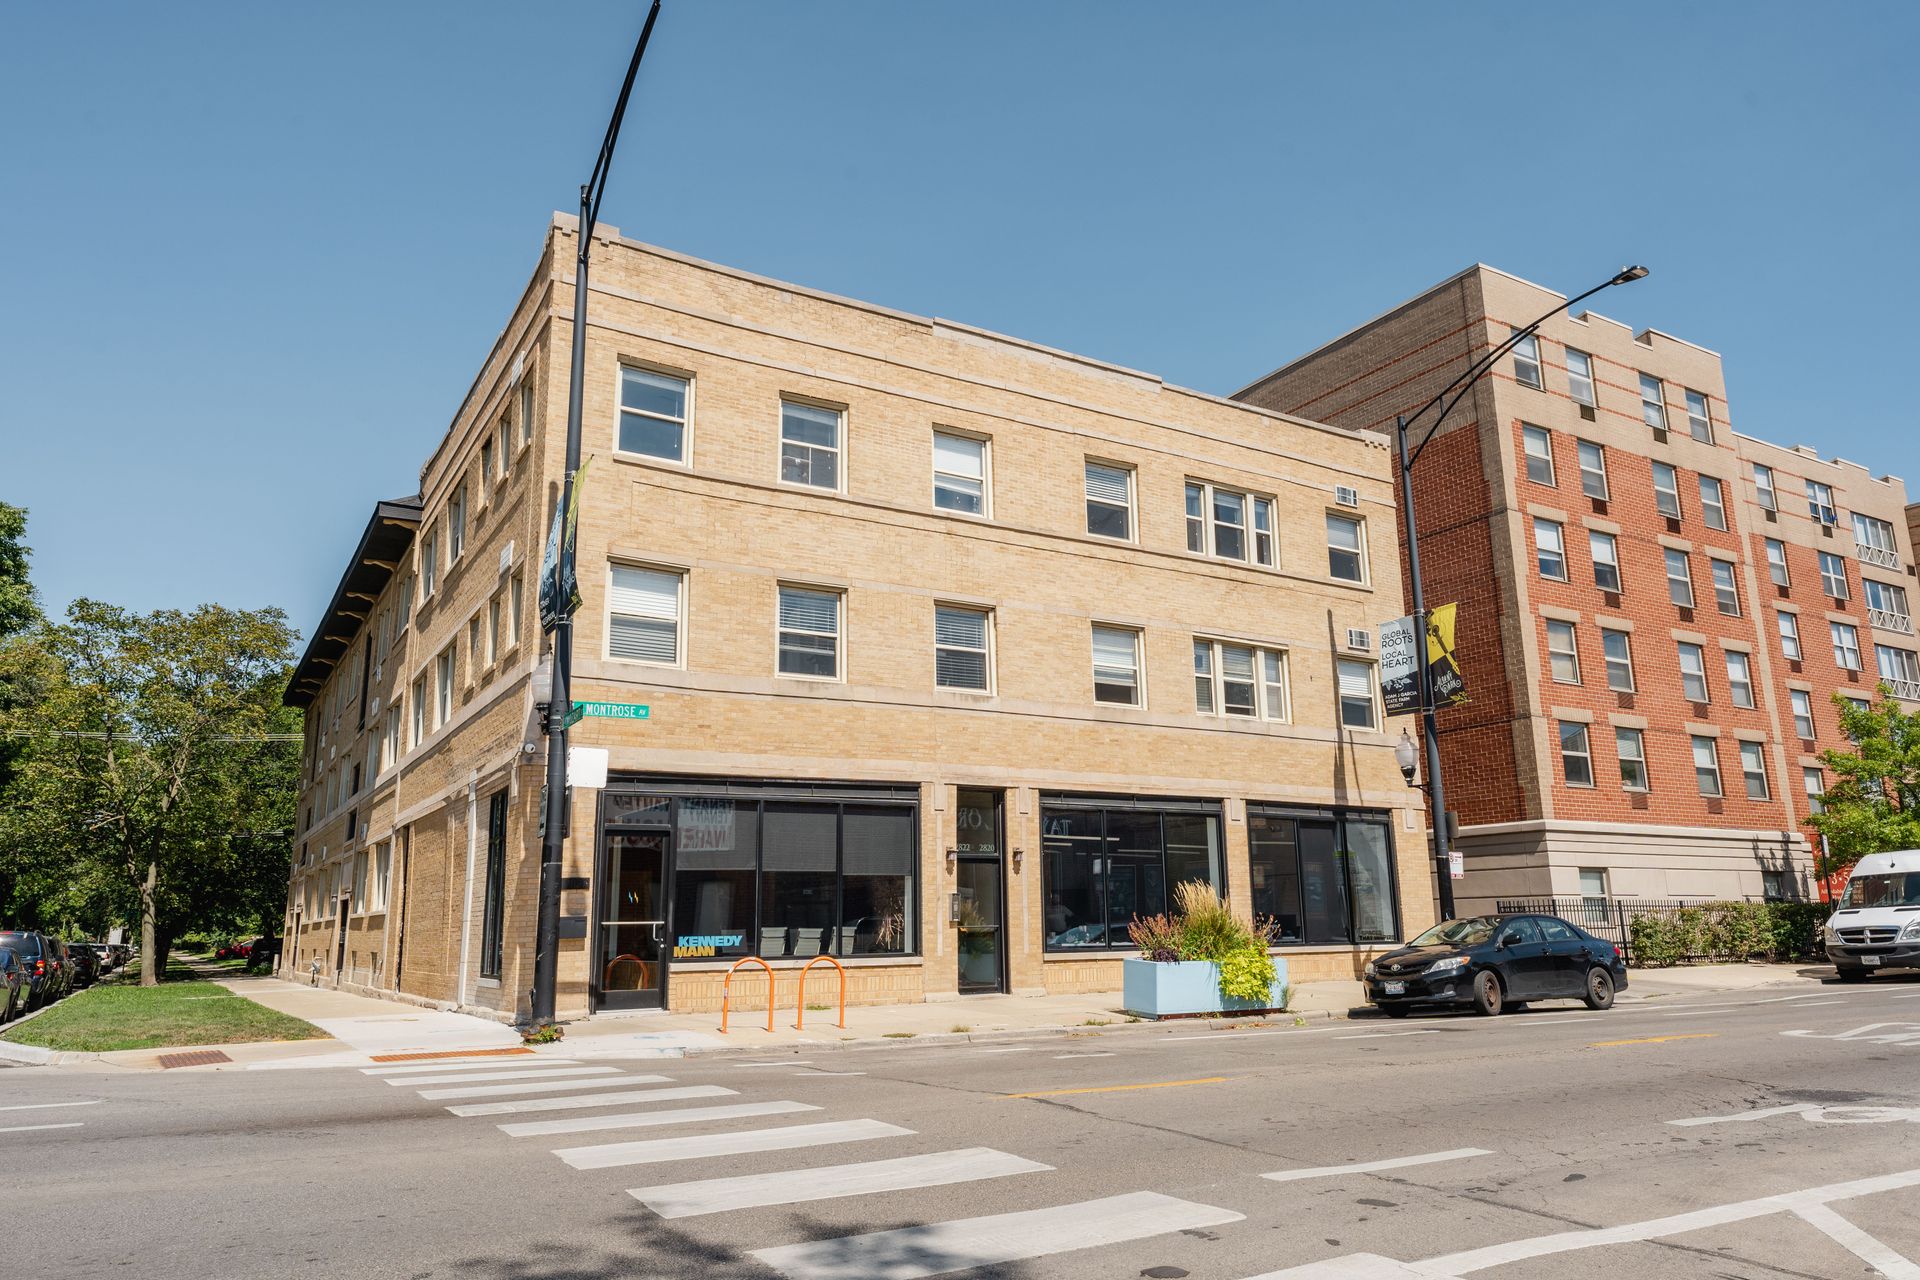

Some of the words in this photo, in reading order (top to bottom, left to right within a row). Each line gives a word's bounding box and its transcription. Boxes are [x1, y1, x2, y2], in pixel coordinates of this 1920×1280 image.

[1382, 628, 1411, 640] GLOBAL
[1382, 635, 1413, 649] ROOTS
[1382, 650, 1406, 660] LOCAL
[1382, 656, 1414, 669] HEART
[586, 703, 636, 717] MONTROSE
[678, 935, 742, 947] KENNEDY
[674, 946, 715, 957] MANN
